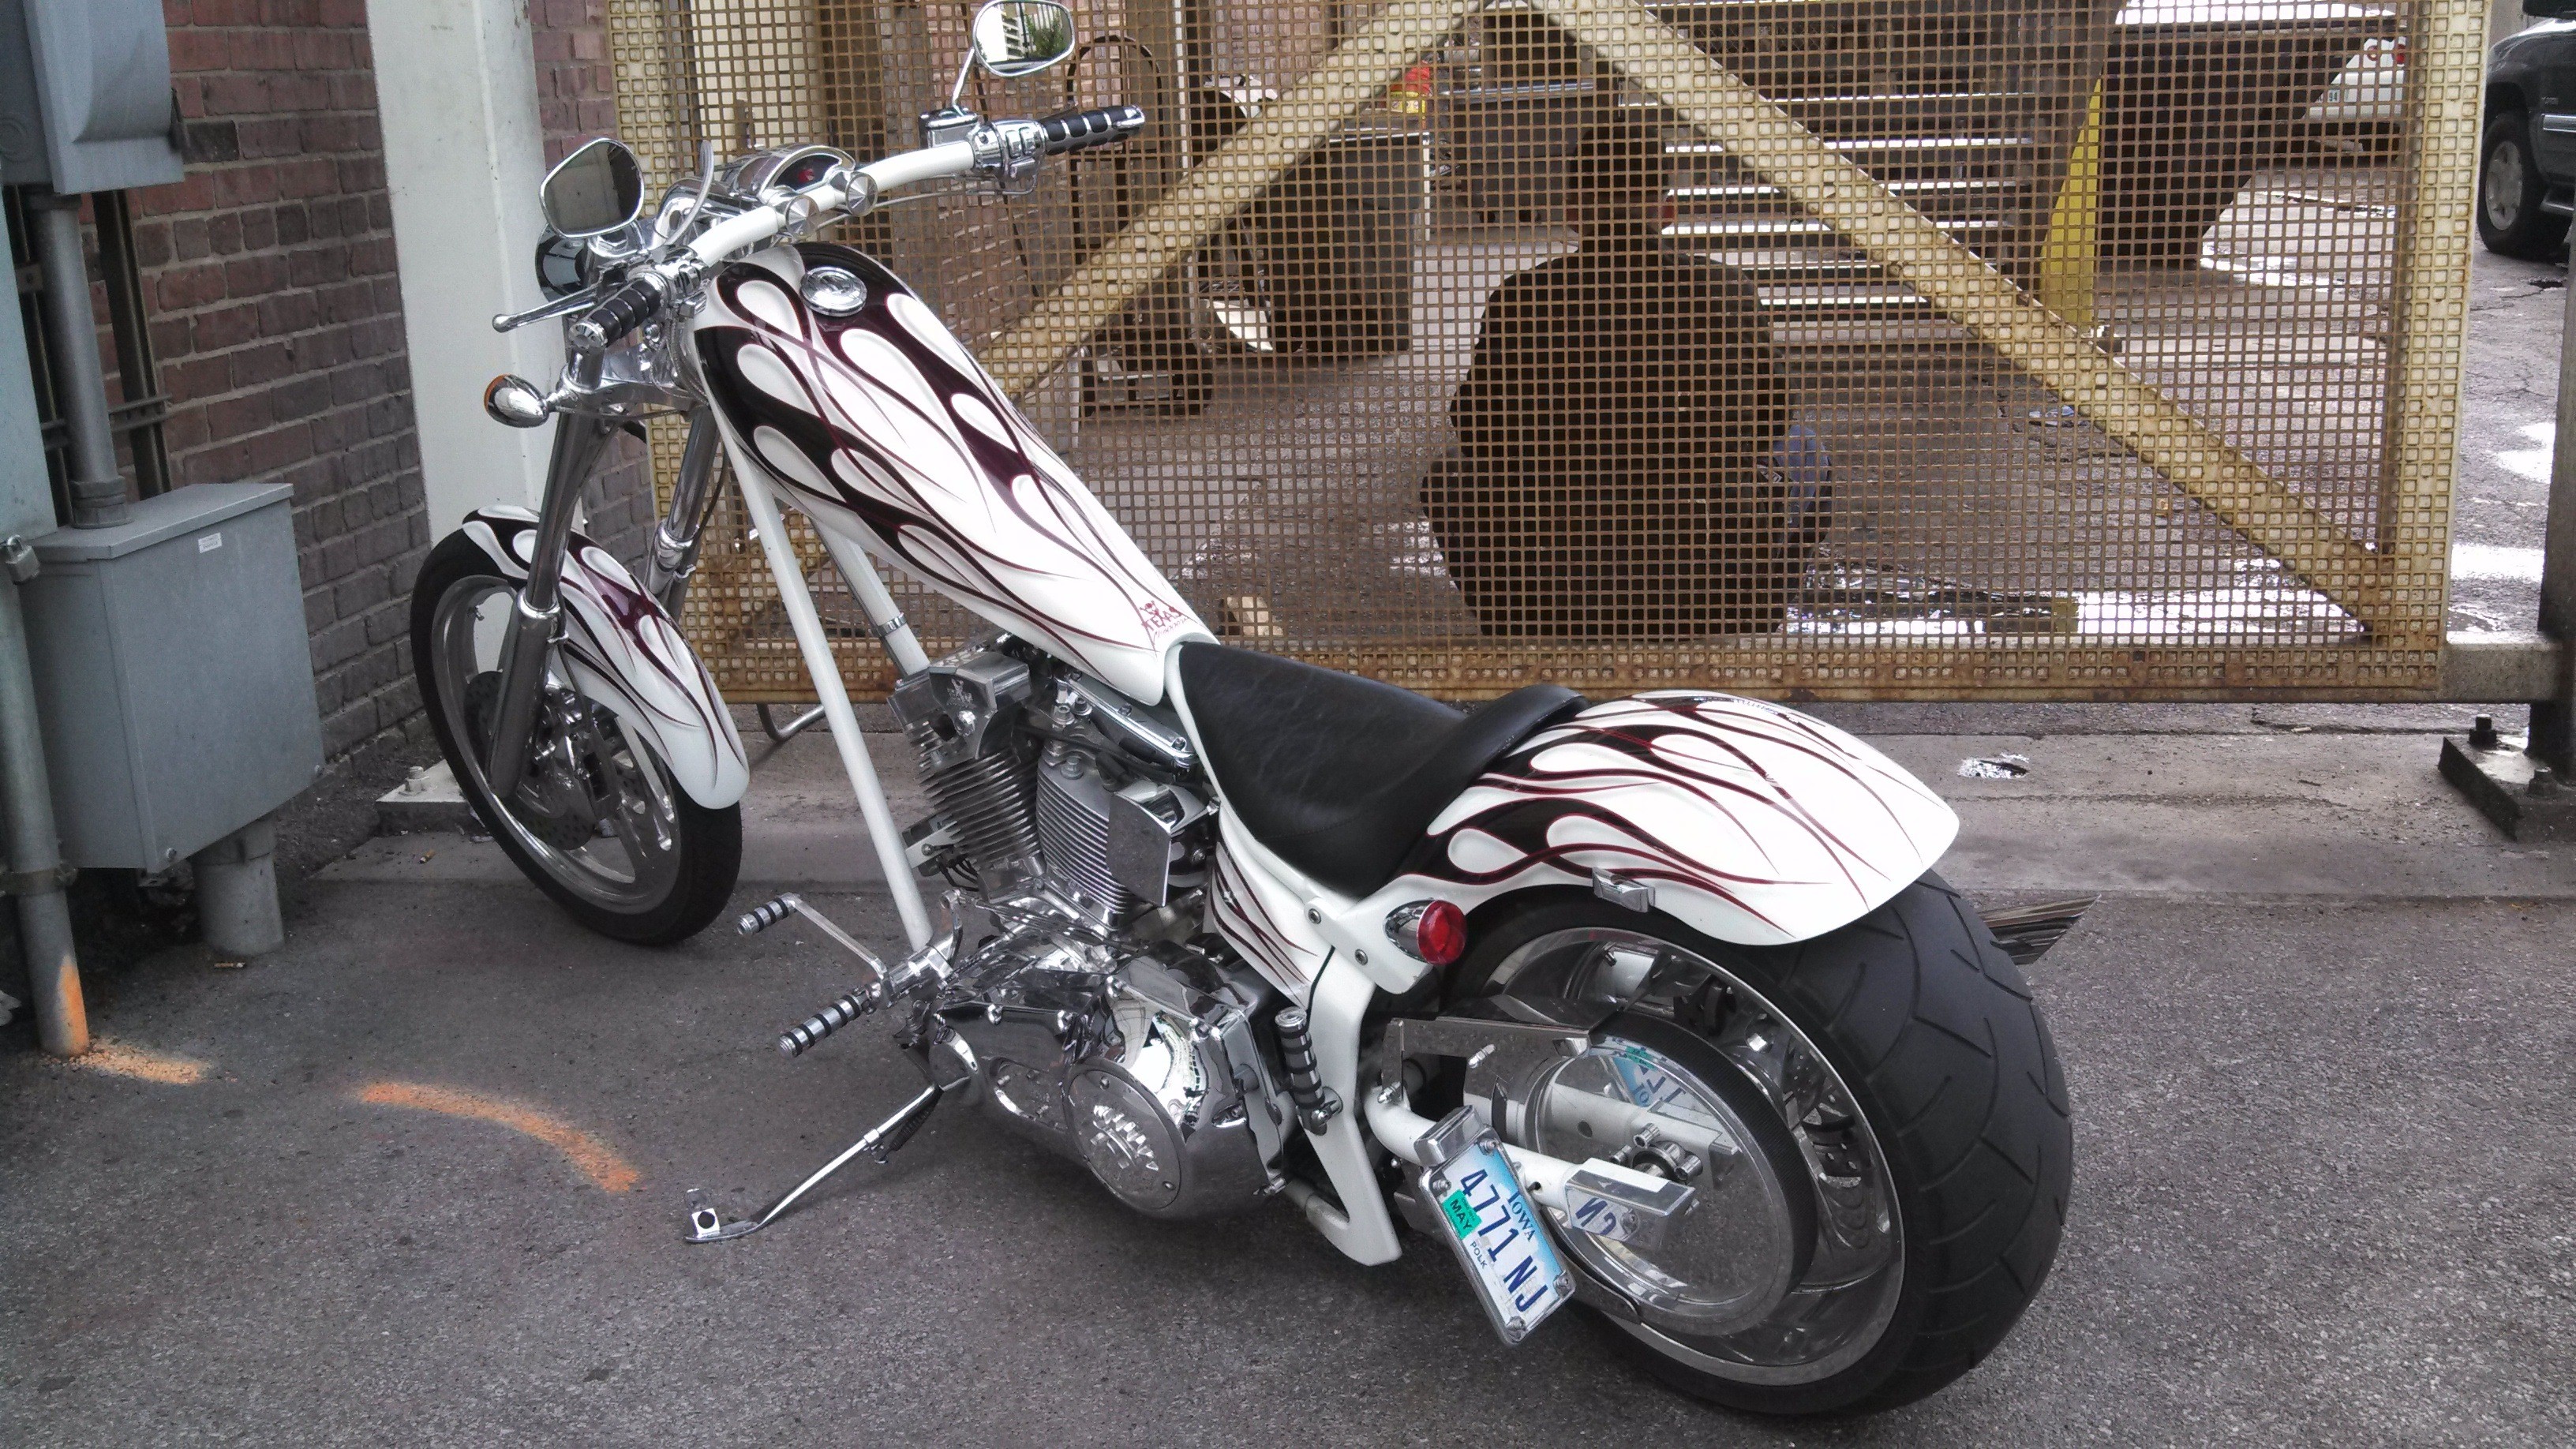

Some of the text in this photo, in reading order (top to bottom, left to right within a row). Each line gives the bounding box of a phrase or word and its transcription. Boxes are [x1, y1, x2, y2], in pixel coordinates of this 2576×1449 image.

[1450, 1199, 1471, 1231] MAY
[1460, 1168, 1548, 1312] 4771 NJ
[1470, 1241, 1487, 1269] POLK
